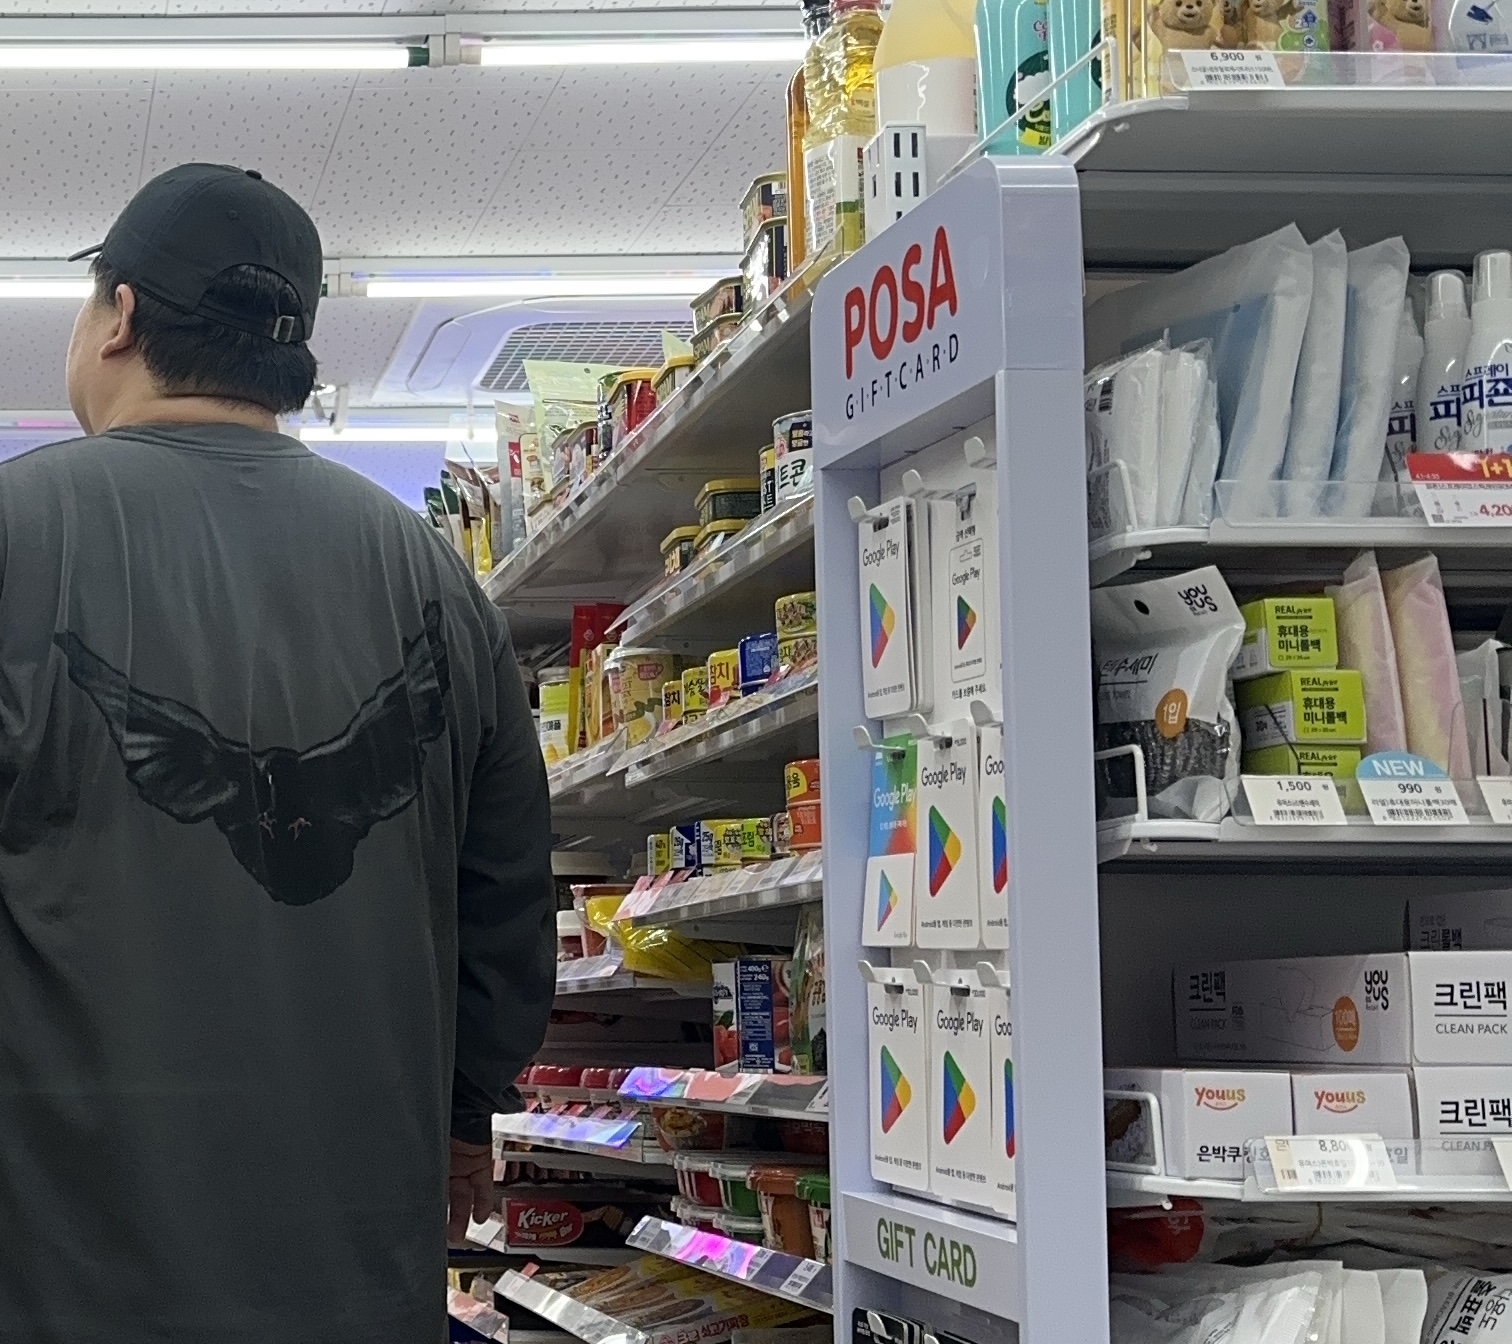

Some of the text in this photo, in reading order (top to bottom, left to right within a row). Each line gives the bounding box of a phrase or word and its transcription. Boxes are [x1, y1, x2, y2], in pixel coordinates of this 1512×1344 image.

[1210, 51, 1245, 62] 6,900
[843, 224, 959, 380] POSA
[862, 539, 900, 567] Google Play
[951, 566, 980, 586] Google Play
[1178, 584, 1208, 606] you
[1275, 605, 1296, 615] REAL
[1277, 624, 1310, 638] 휴대용
[1278, 638, 1321, 653] 미니롤백
[1300, 677, 1322, 687] REAL
[1302, 696, 1336, 711] 휴대용
[1303, 710, 1348, 725] 미니롤백
[1299, 751, 1321, 761] REAL
[921, 761, 967, 789] Google Play
[1372, 759, 1425, 777] NEW
[873, 783, 917, 812] Google Play
[1276, 781, 1312, 793] 1,500
[1397, 783, 1423, 795] 990
[1189, 970, 1227, 1003] 크린팩
[1433, 980, 1509, 1011] 크린팩
[872, 1006, 918, 1033] Google Play
[937, 1009, 984, 1038] Google Play
[1435, 1023, 1509, 1035] CLEAN PACK
[1194, 1087, 1247, 1109] youus
[1313, 1090, 1367, 1111] youus
[1439, 1098, 1512, 1128] 크린팩
[517, 1206, 569, 1229] Kicker
[876, 1215, 978, 1290] GIFT CARD
